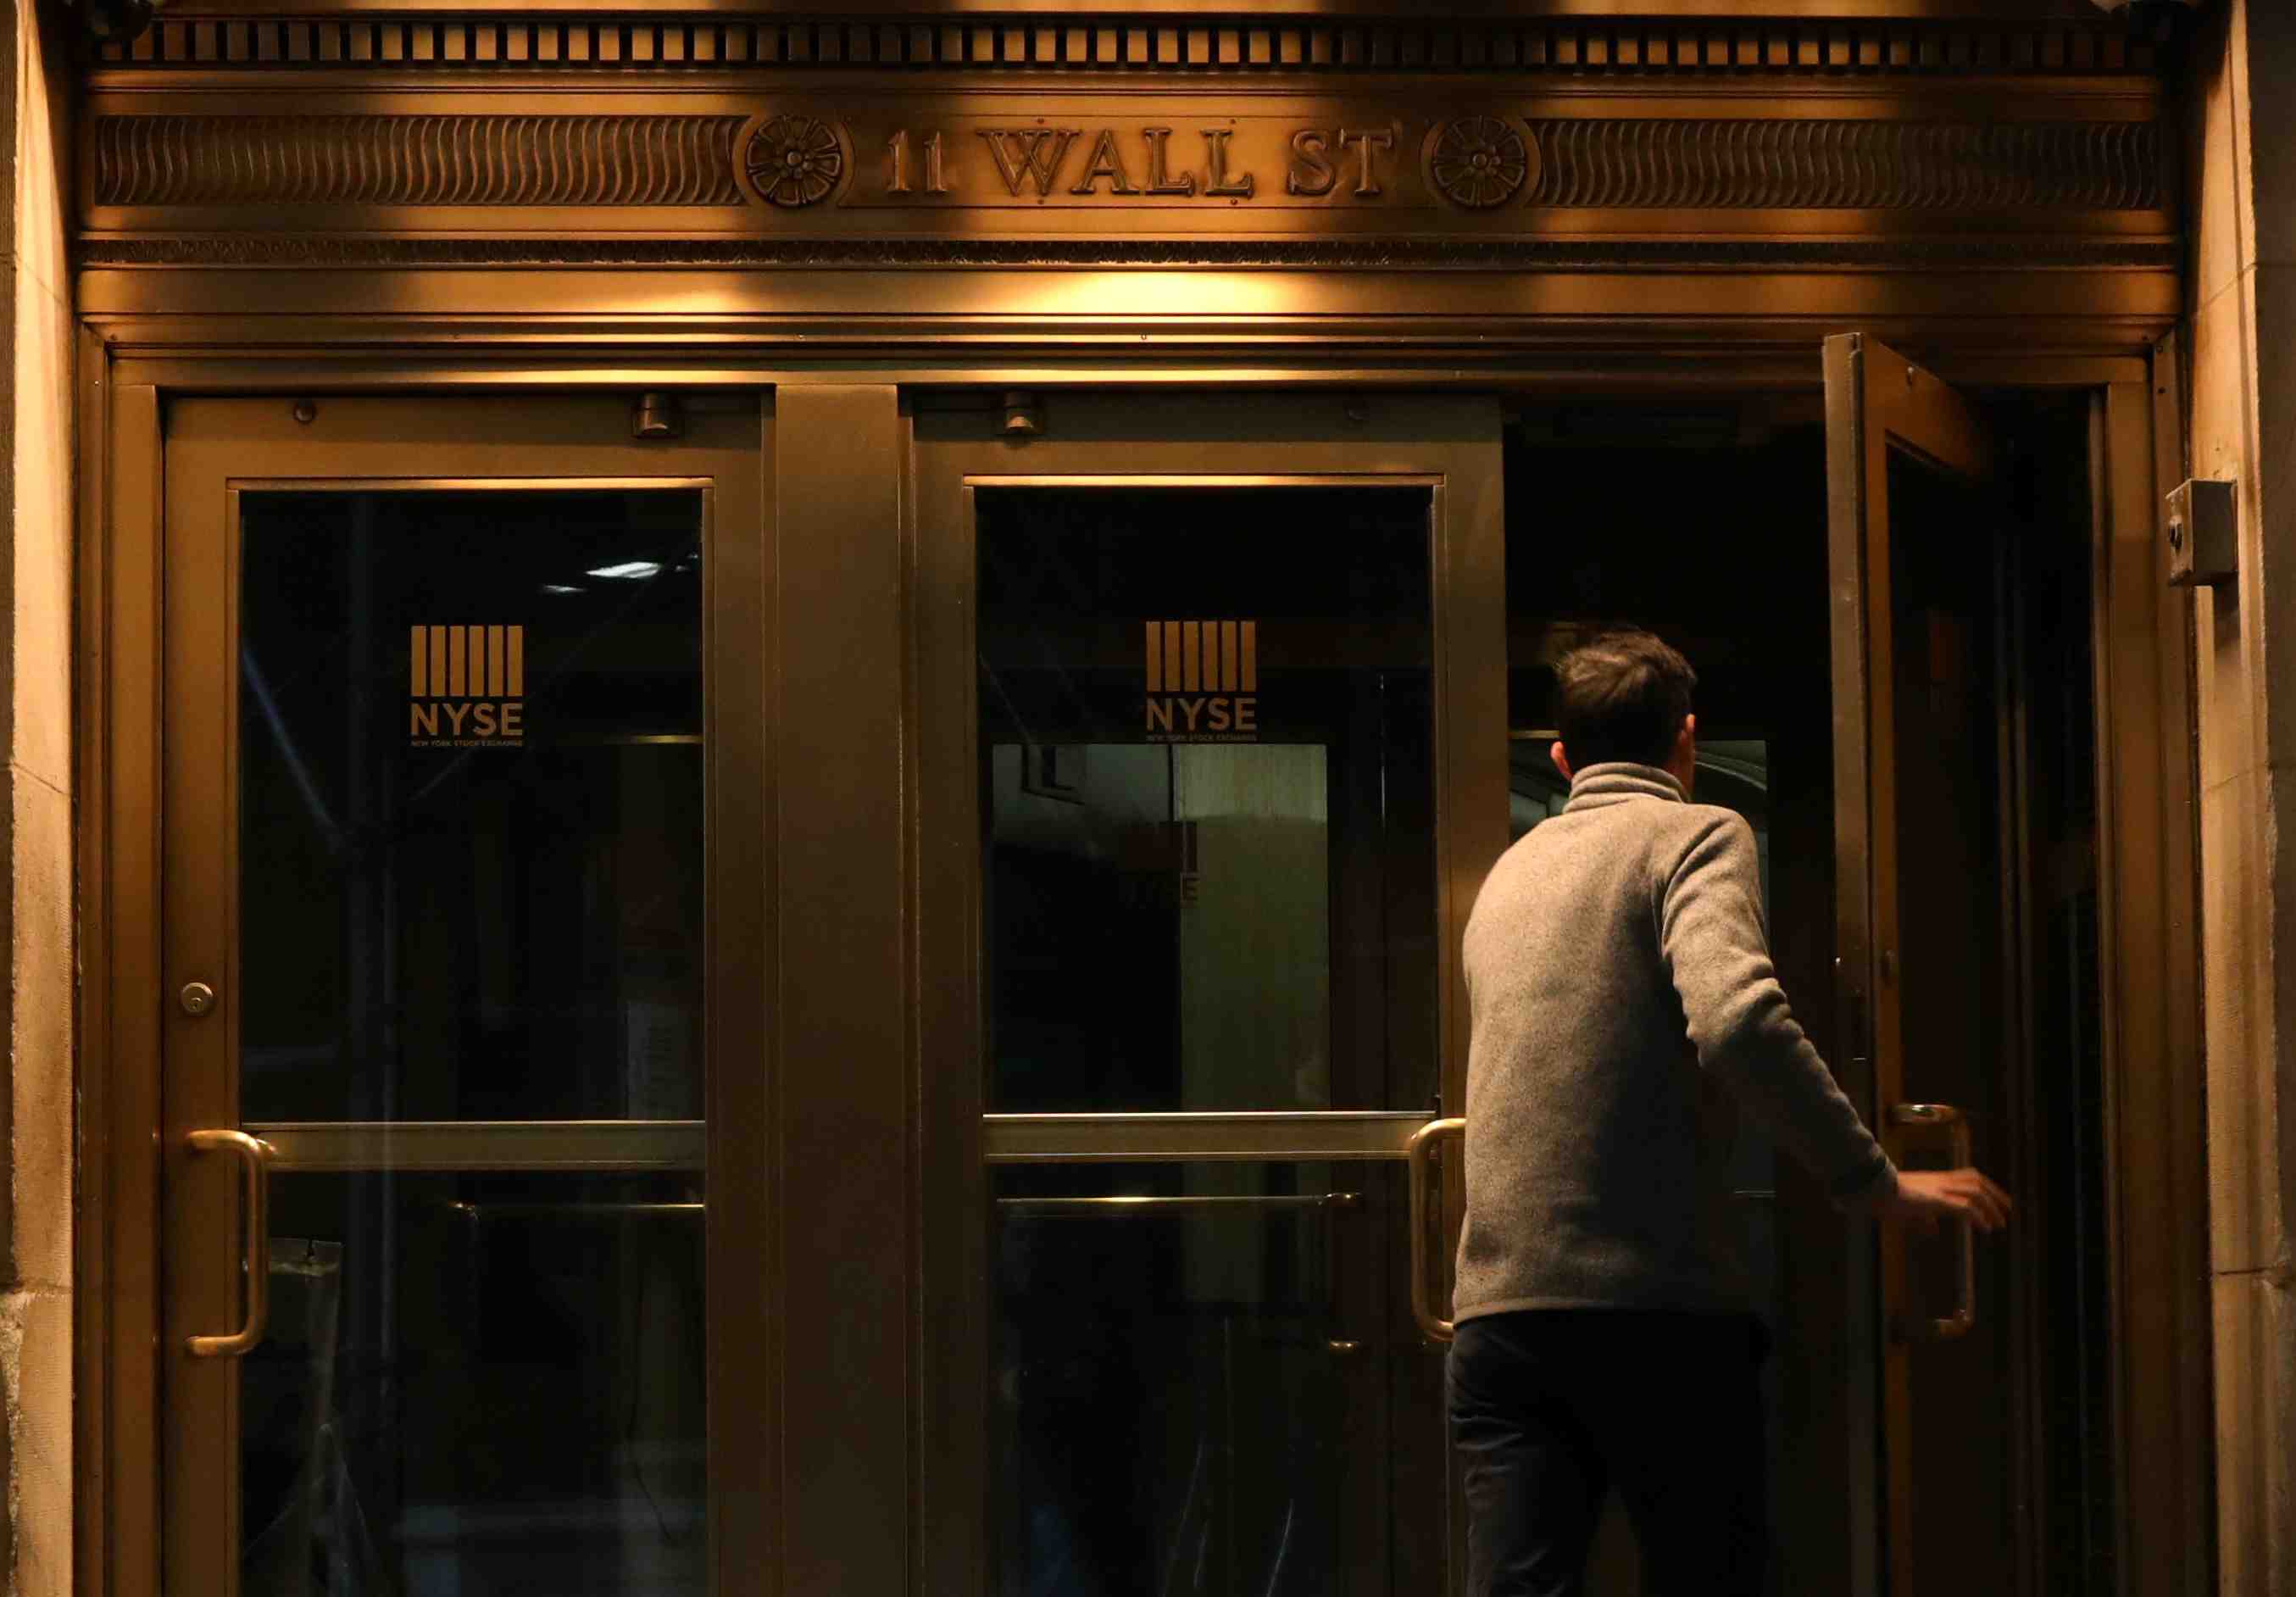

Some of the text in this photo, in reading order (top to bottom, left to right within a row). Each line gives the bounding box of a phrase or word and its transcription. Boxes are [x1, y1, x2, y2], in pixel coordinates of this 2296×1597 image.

[887, 127, 1393, 199] 11 WALL ST
[409, 702, 523, 736] NYSE
[1145, 697, 1258, 732] NYSE
